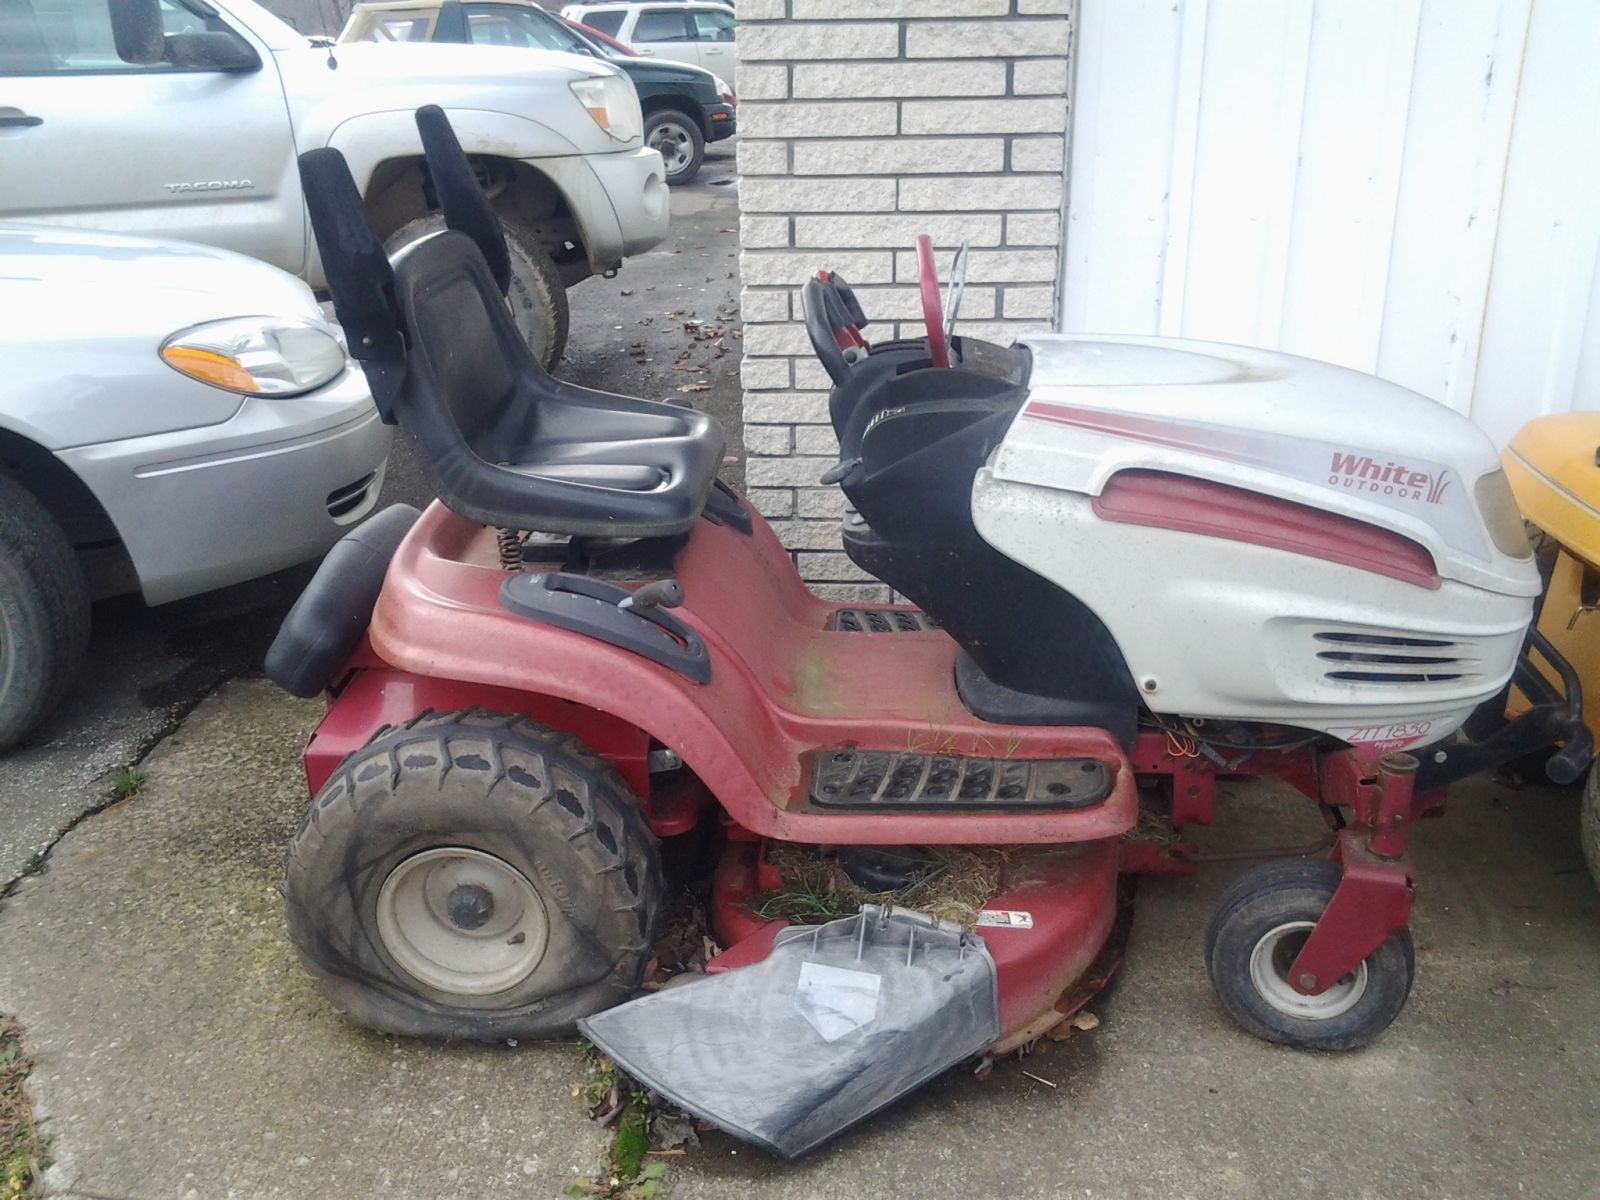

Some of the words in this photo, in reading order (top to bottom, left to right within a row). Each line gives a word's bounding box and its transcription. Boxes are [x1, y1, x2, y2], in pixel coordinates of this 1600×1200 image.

[162, 179, 255, 193] TACOMA
[1330, 452, 1428, 488] White
[1328, 475, 1421, 500] OUTDOOR
